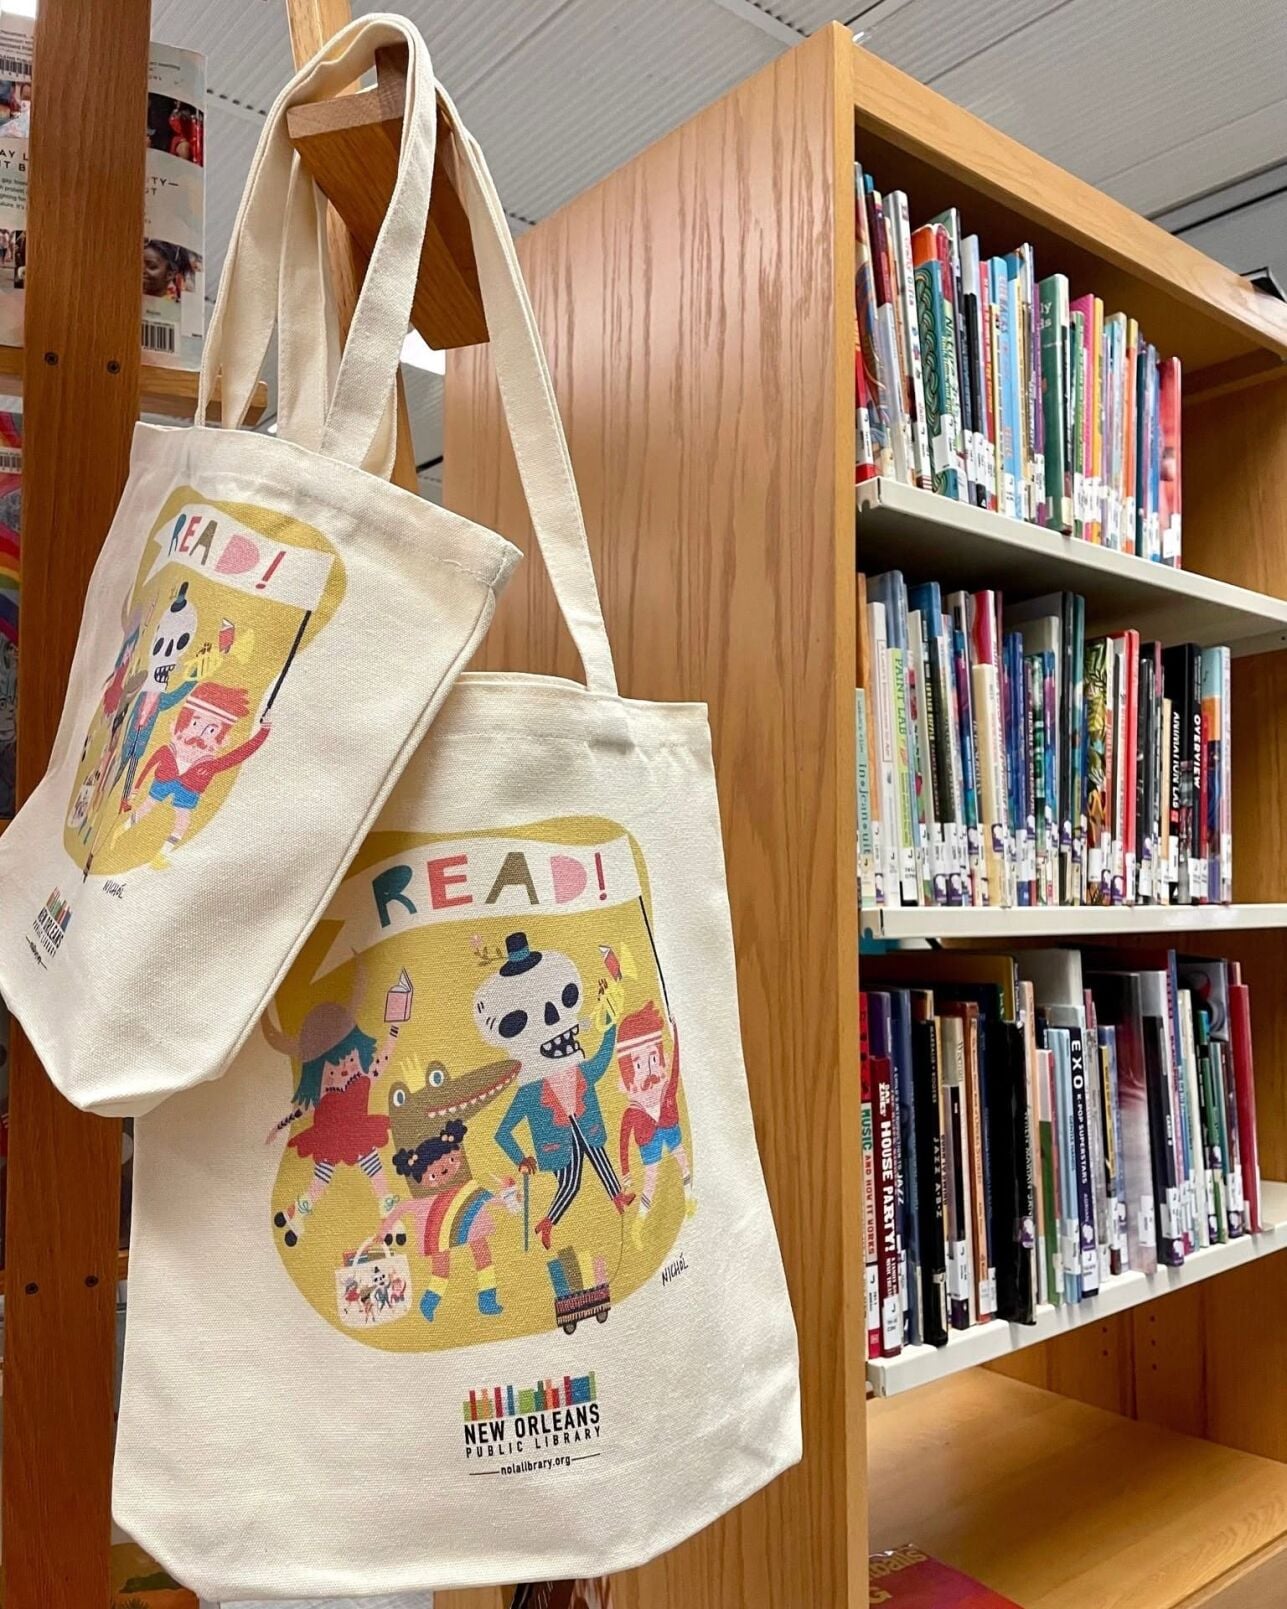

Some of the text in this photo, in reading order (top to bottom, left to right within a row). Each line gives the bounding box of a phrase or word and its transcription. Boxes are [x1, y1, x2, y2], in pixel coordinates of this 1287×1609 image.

[168, 513, 288, 590] READ!
[895, 658, 908, 735] PAINT LAB
[1172, 712, 1181, 809] ANIMATION LAB
[1193, 713, 1202, 789] OVERVIEW
[372, 851, 607, 929] READ!
[1071, 1040, 1084, 1090] EXO
[1076, 1093, 1084, 1123] K-POP
[861, 1108, 875, 1255] MUSIC AND HOW IT WORKS
[880, 1120, 893, 1182] HOUSE
[932, 1136, 942, 1175] JAZZ
[1078, 1124, 1088, 1185] SUPERSTARS
[882, 1185, 896, 1253] PARTY!
[897, 1172, 905, 1206] JAZZ
[464, 1403, 601, 1445] NEW ORLEANS
[465, 1426, 602, 1459] PUBLIC LIBRARY
[500, 1456, 572, 1476] nolalibrary.org
